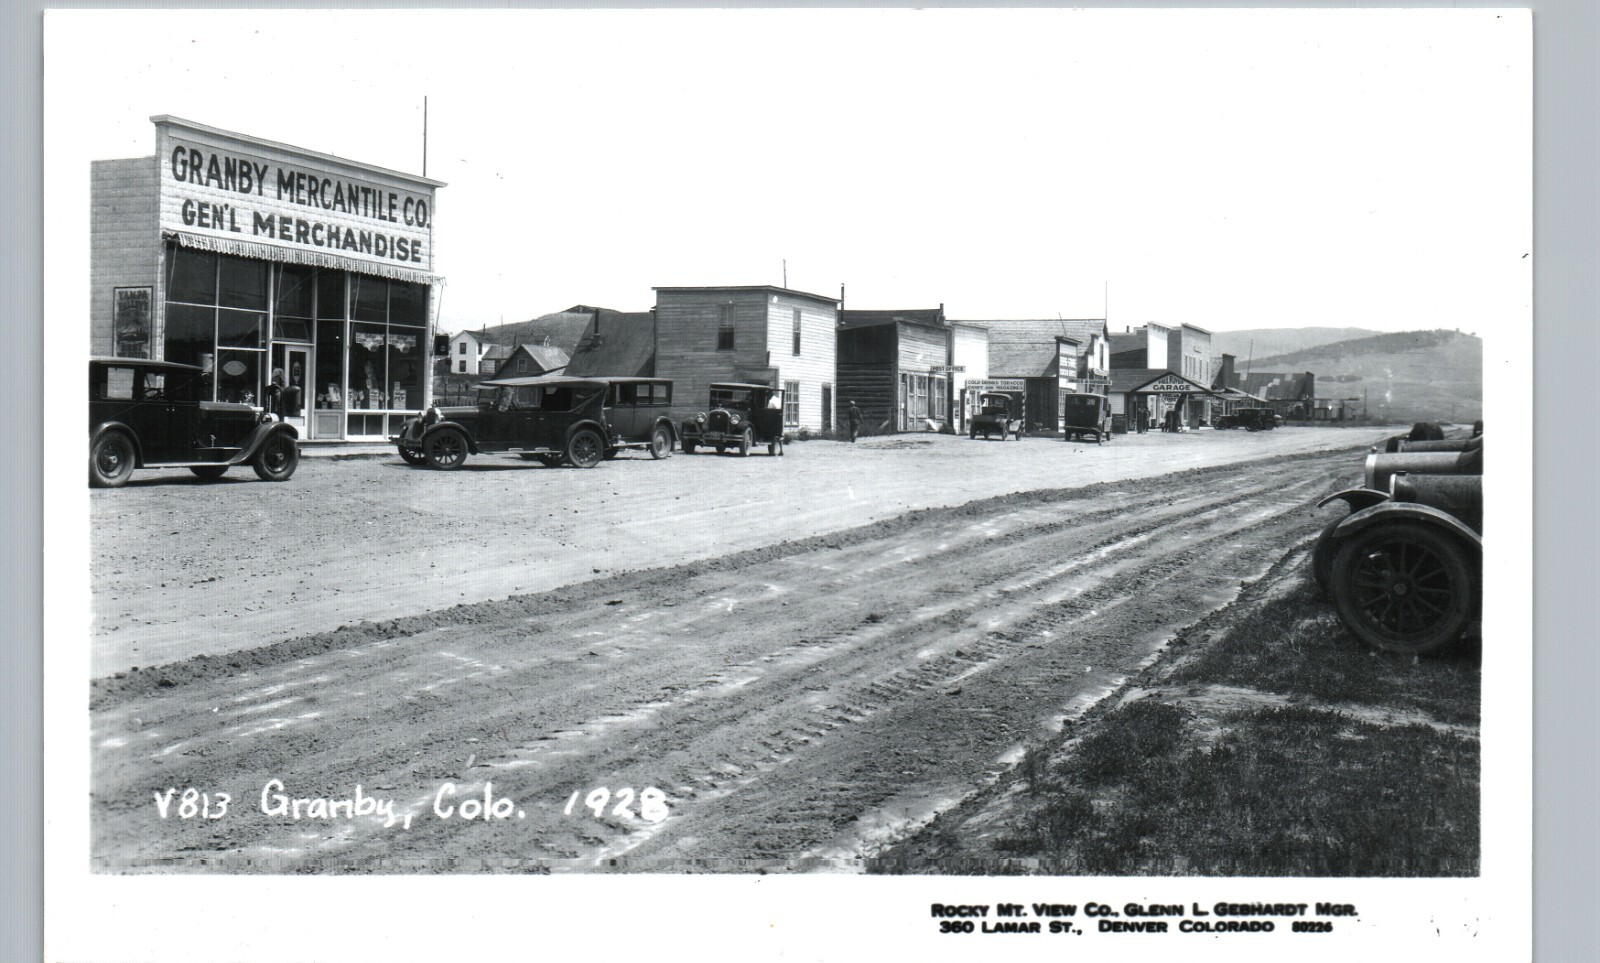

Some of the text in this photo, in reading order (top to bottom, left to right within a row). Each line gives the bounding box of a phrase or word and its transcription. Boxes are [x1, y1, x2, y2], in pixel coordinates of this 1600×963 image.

[171, 145, 431, 229] GRANBY MERCANTILE CO.
[181, 199, 422, 263] GEN'L MERCHANDISE
[118, 290, 148, 300] YAMPA
